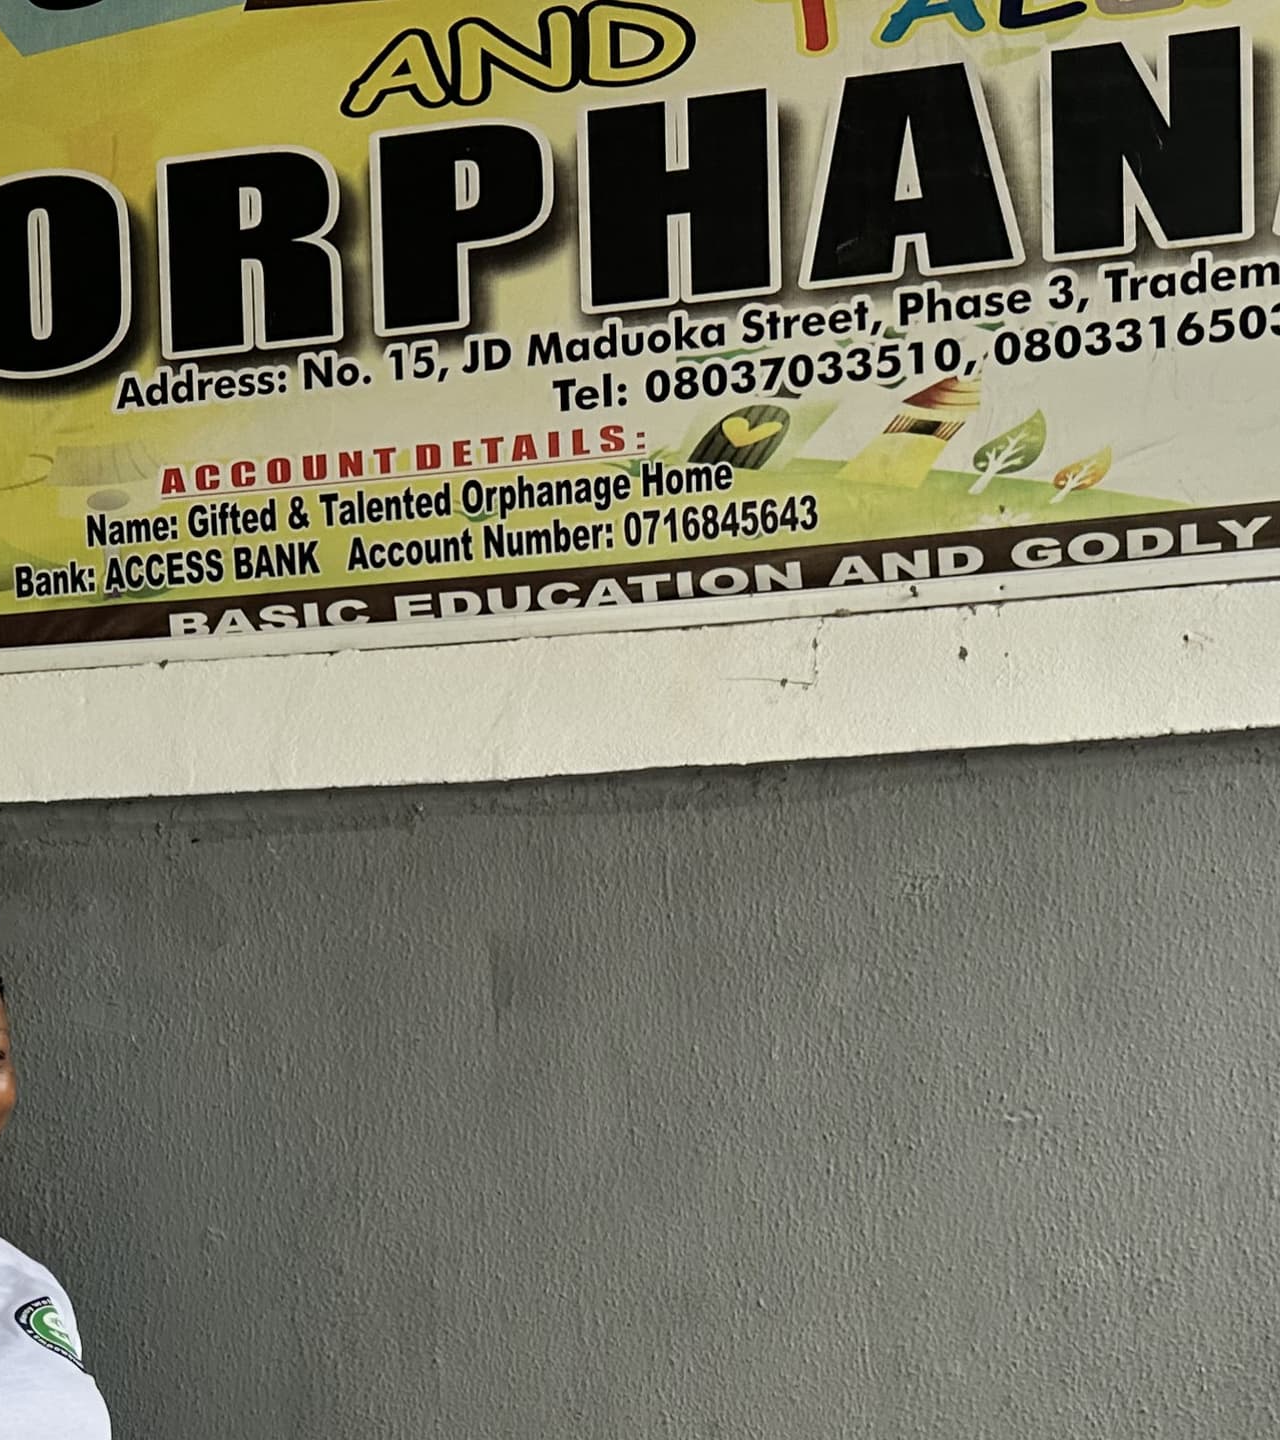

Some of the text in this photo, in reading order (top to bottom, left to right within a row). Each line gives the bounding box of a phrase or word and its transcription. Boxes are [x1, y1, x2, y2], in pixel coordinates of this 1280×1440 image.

[341, 2, 696, 118] AND
[117, 368, 287, 410] Address:
[304, 355, 372, 390] No.
[389, 345, 448, 383] 15,
[462, 338, 511, 374] JD
[527, 315, 725, 366] Maduoka
[742, 300, 883, 342] Street,
[899, 284, 1031, 326] Phase
[1048, 275, 1089, 312] 3,
[553, 373, 628, 412] Tel:
[646, 337, 978, 404] 08037033510,
[86, 462, 734, 547] Name: Gifted & Talented Orphanage Home
[161, 425, 646, 494] ACCOUNT DETAILS:
[15, 495, 819, 598] Bank: ACCESS BANK Account Number: 0716845643
[168, 599, 370, 638] BASIC
[393, 561, 803, 622] EDUCATION
[828, 545, 984, 586] AND
[1011, 516, 1272, 569] GODLY
